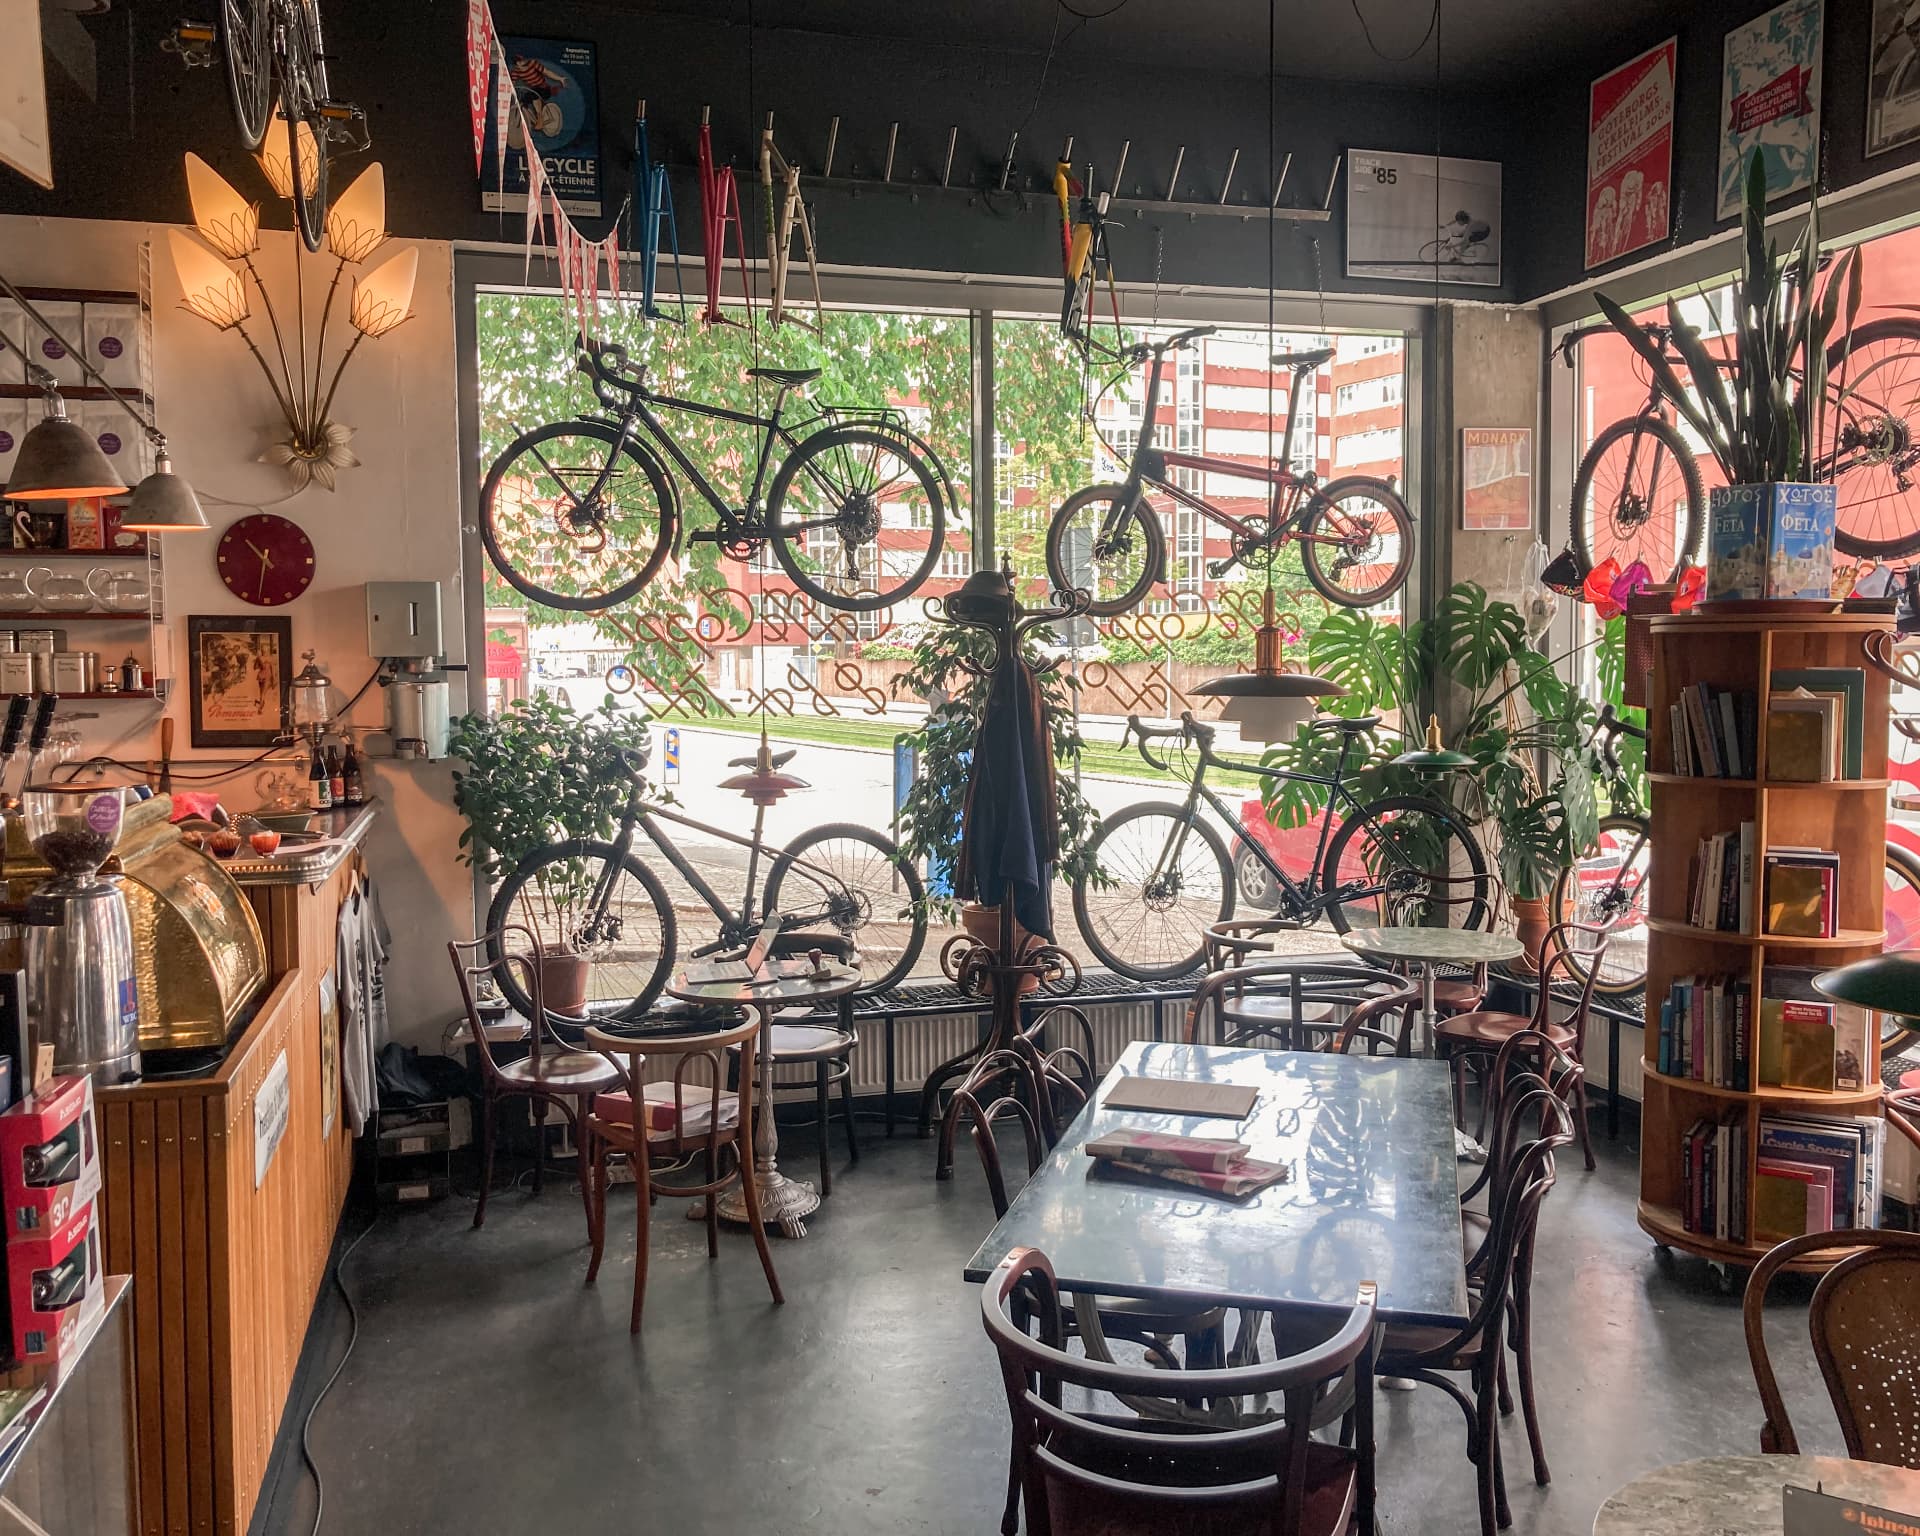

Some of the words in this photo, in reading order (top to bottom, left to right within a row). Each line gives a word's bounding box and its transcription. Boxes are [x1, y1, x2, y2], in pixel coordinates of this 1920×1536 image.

[543, 157, 595, 175] CYCLE
[1468, 432, 1526, 445] MONARK
[1766, 1136, 1806, 1150] Cycle
